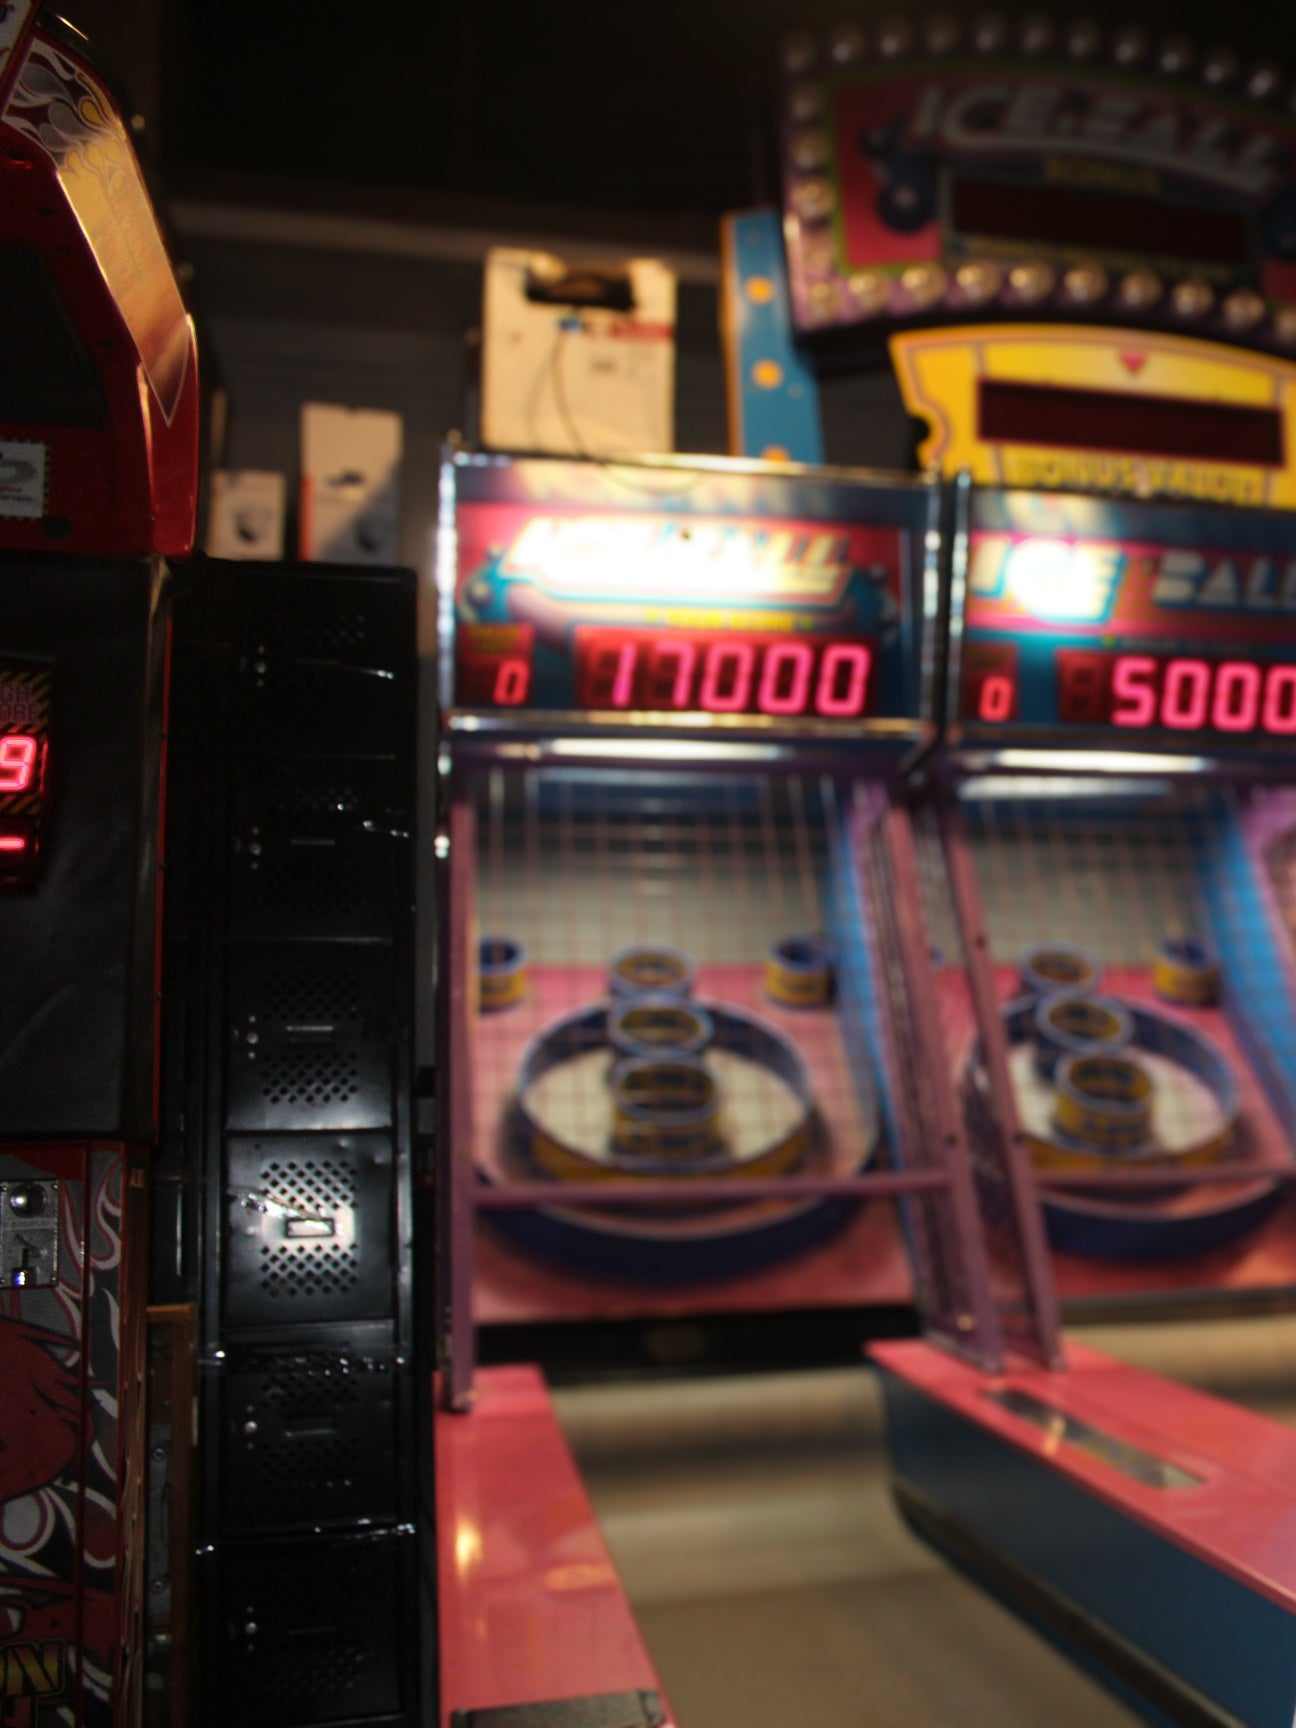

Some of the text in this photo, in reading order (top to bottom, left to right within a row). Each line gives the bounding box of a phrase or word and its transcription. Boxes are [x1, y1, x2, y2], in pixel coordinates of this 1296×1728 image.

[493, 660, 531, 707] 0
[611, 640, 870, 717] 17000
[979, 676, 1014, 722] 0
